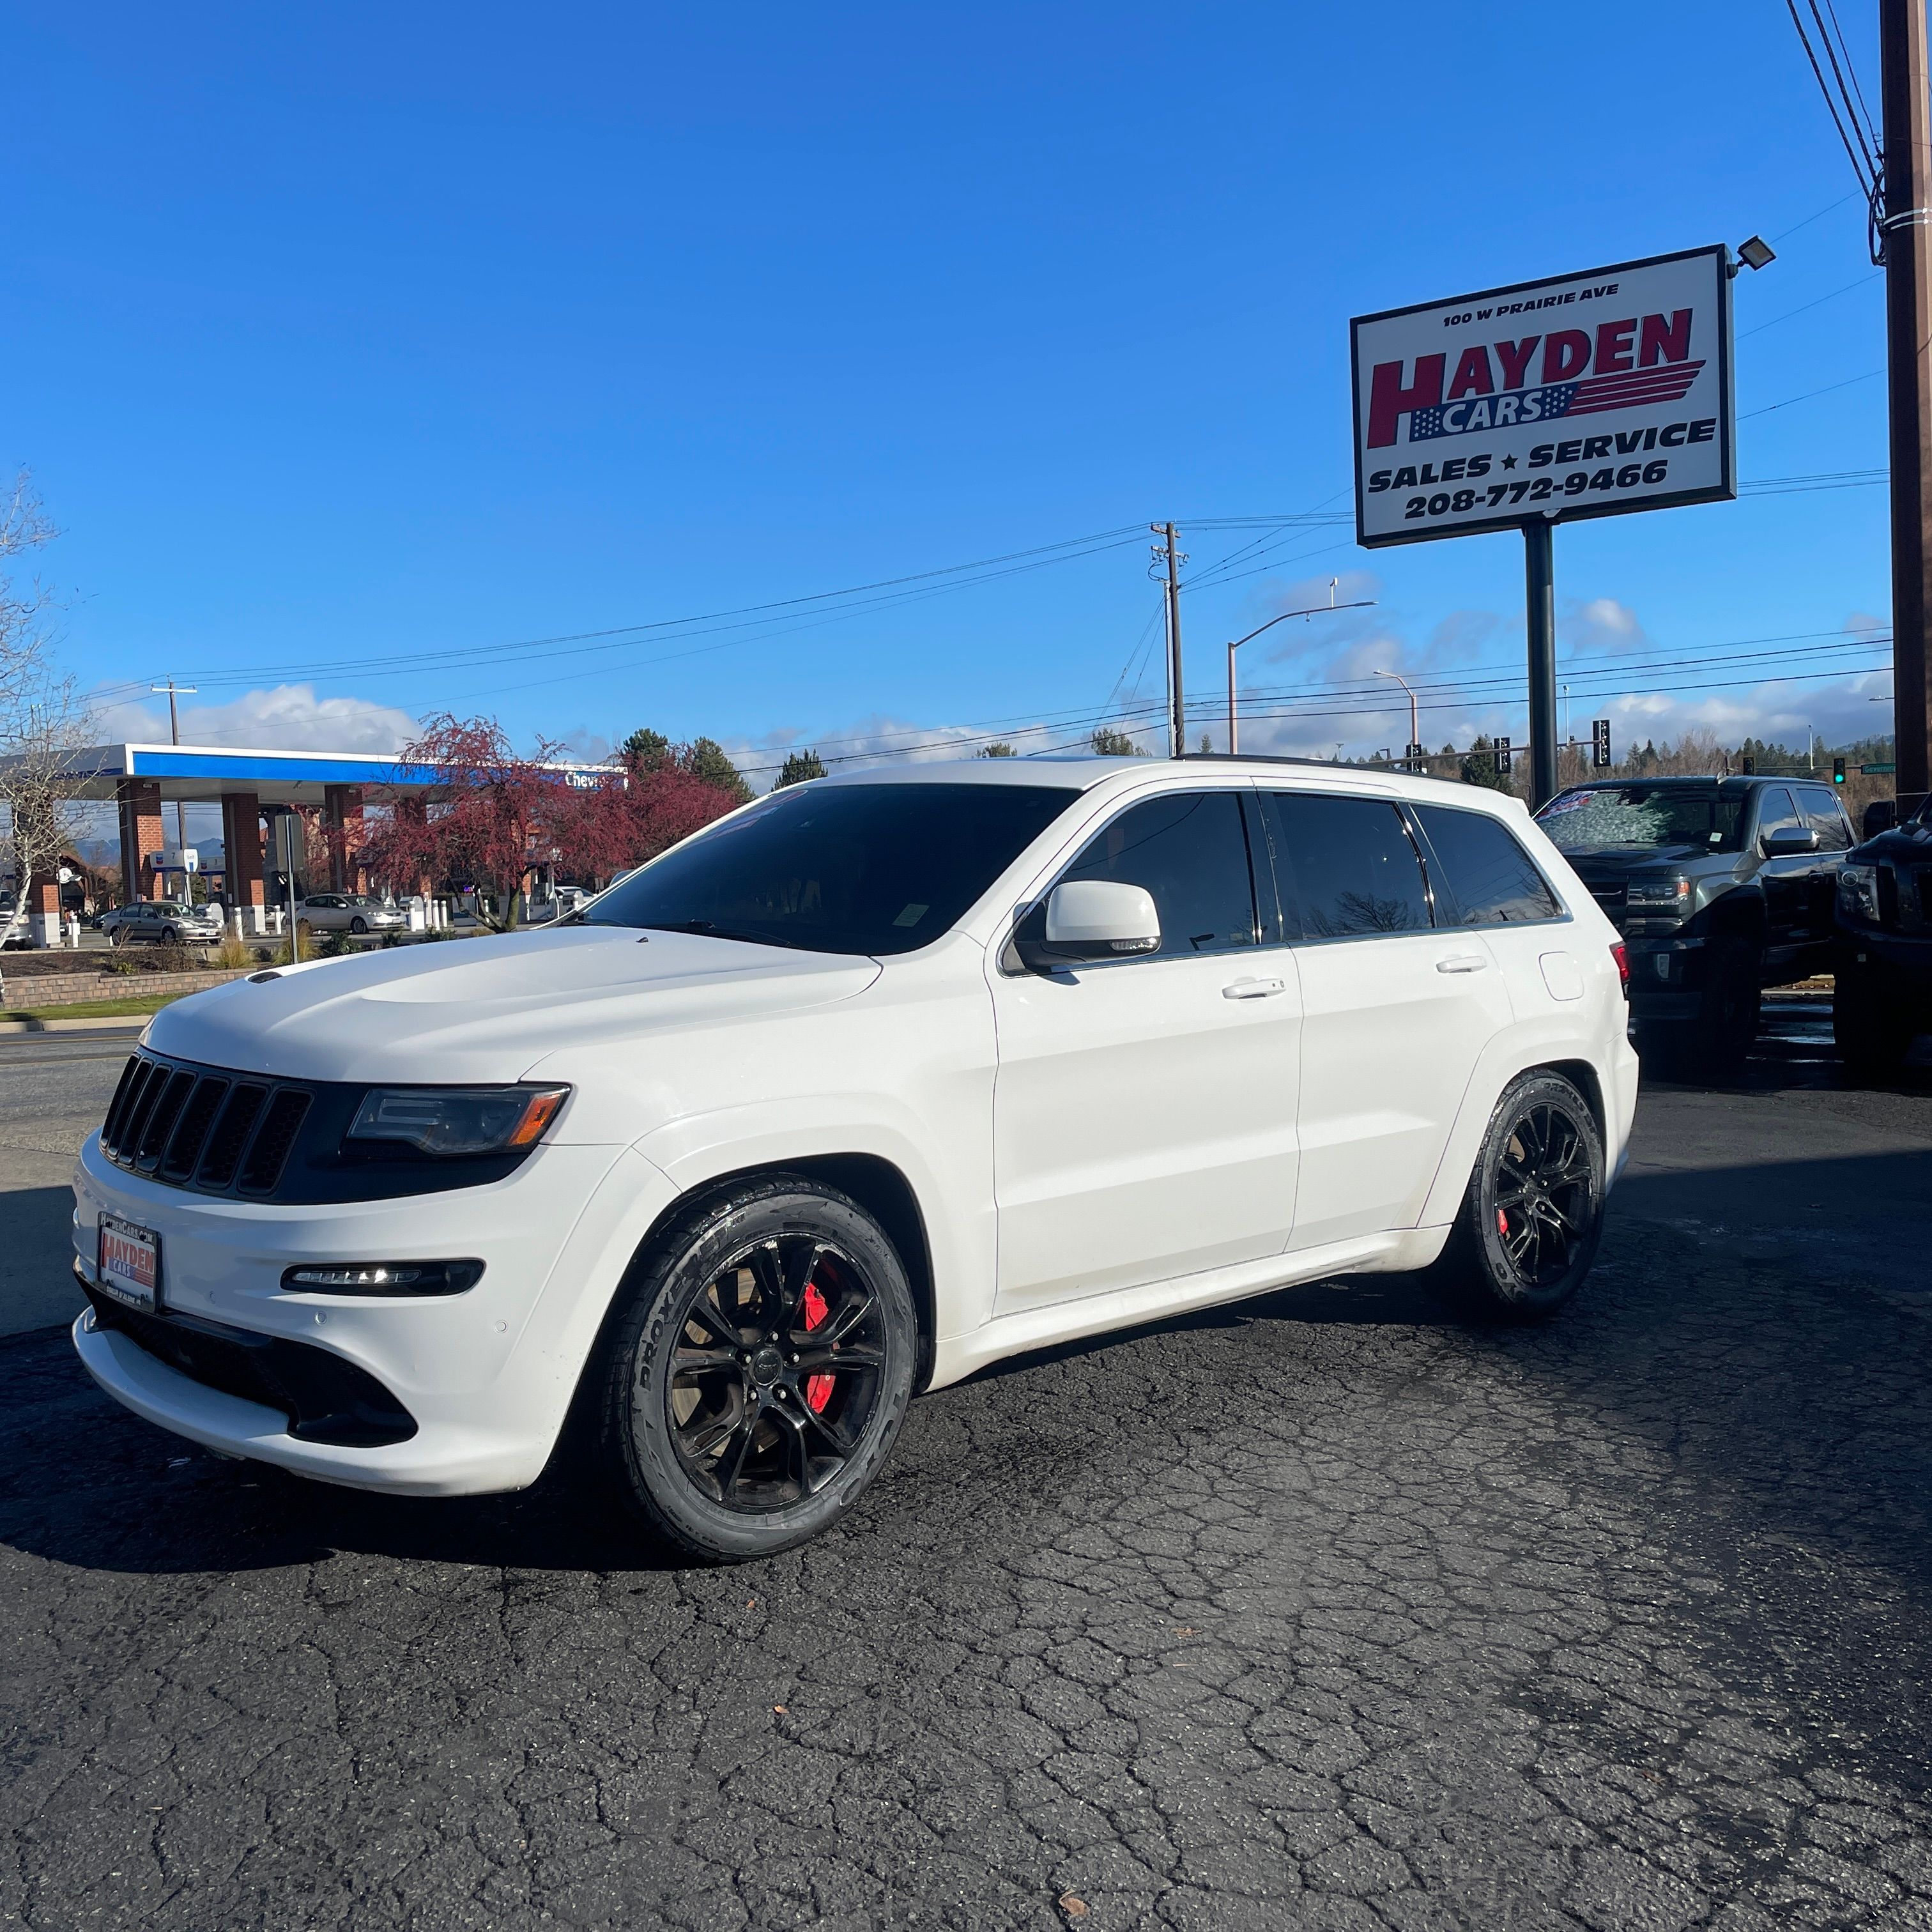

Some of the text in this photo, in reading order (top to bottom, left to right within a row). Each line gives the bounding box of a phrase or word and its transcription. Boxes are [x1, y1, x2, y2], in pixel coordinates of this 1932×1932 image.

[1443, 284, 1620, 327] 100 W PRAIRIE AVE
[1367, 308, 1693, 450] HAYDEN
[1442, 391, 1543, 433] CARS
[1368, 418, 1717, 493] SALES SERVICE
[1405, 459, 1669, 519] 208-772-9466
[565, 771, 607, 788] Chev
[102, 1232, 155, 1274] HAYDEN
[112, 1259, 131, 1277] CARS
